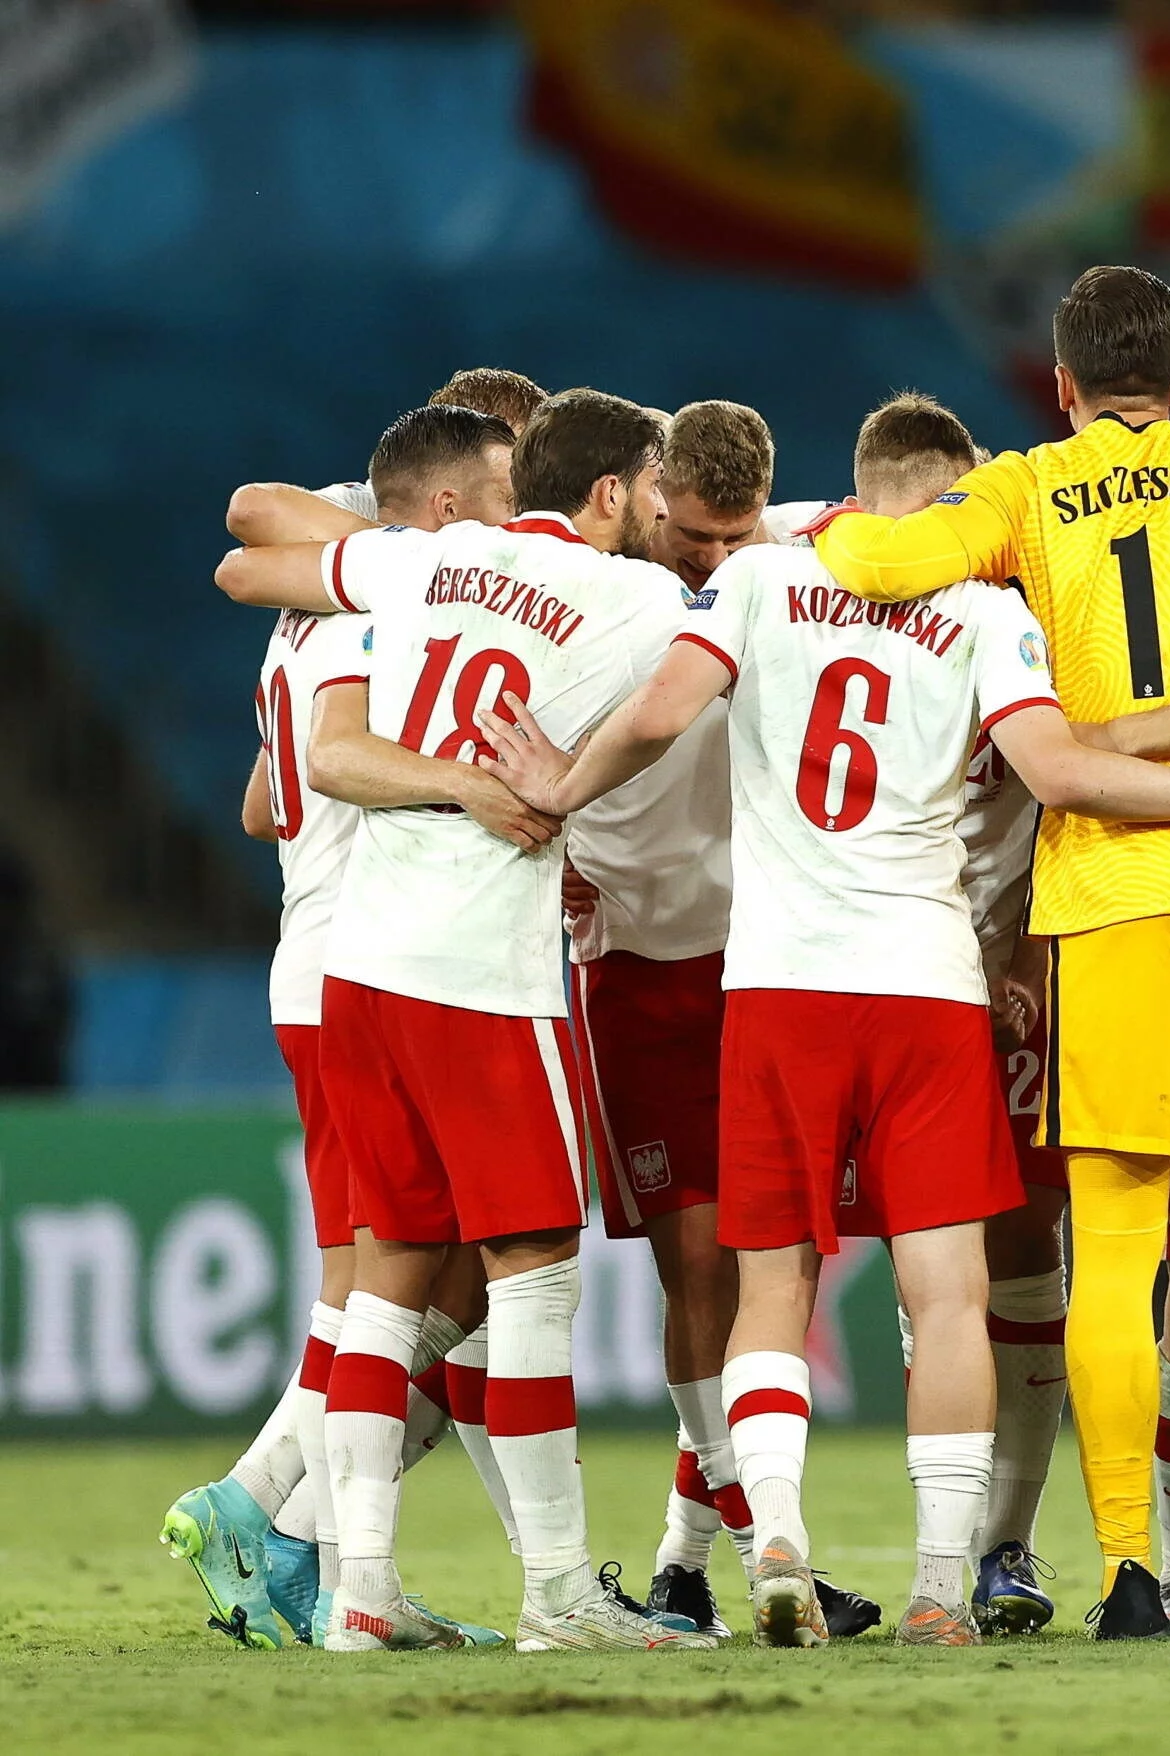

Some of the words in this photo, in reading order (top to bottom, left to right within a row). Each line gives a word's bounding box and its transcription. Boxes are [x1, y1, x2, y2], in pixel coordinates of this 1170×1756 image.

[397, 632, 531, 766] 18
[1109, 524, 1165, 700] 1
[796, 656, 892, 833] 6
